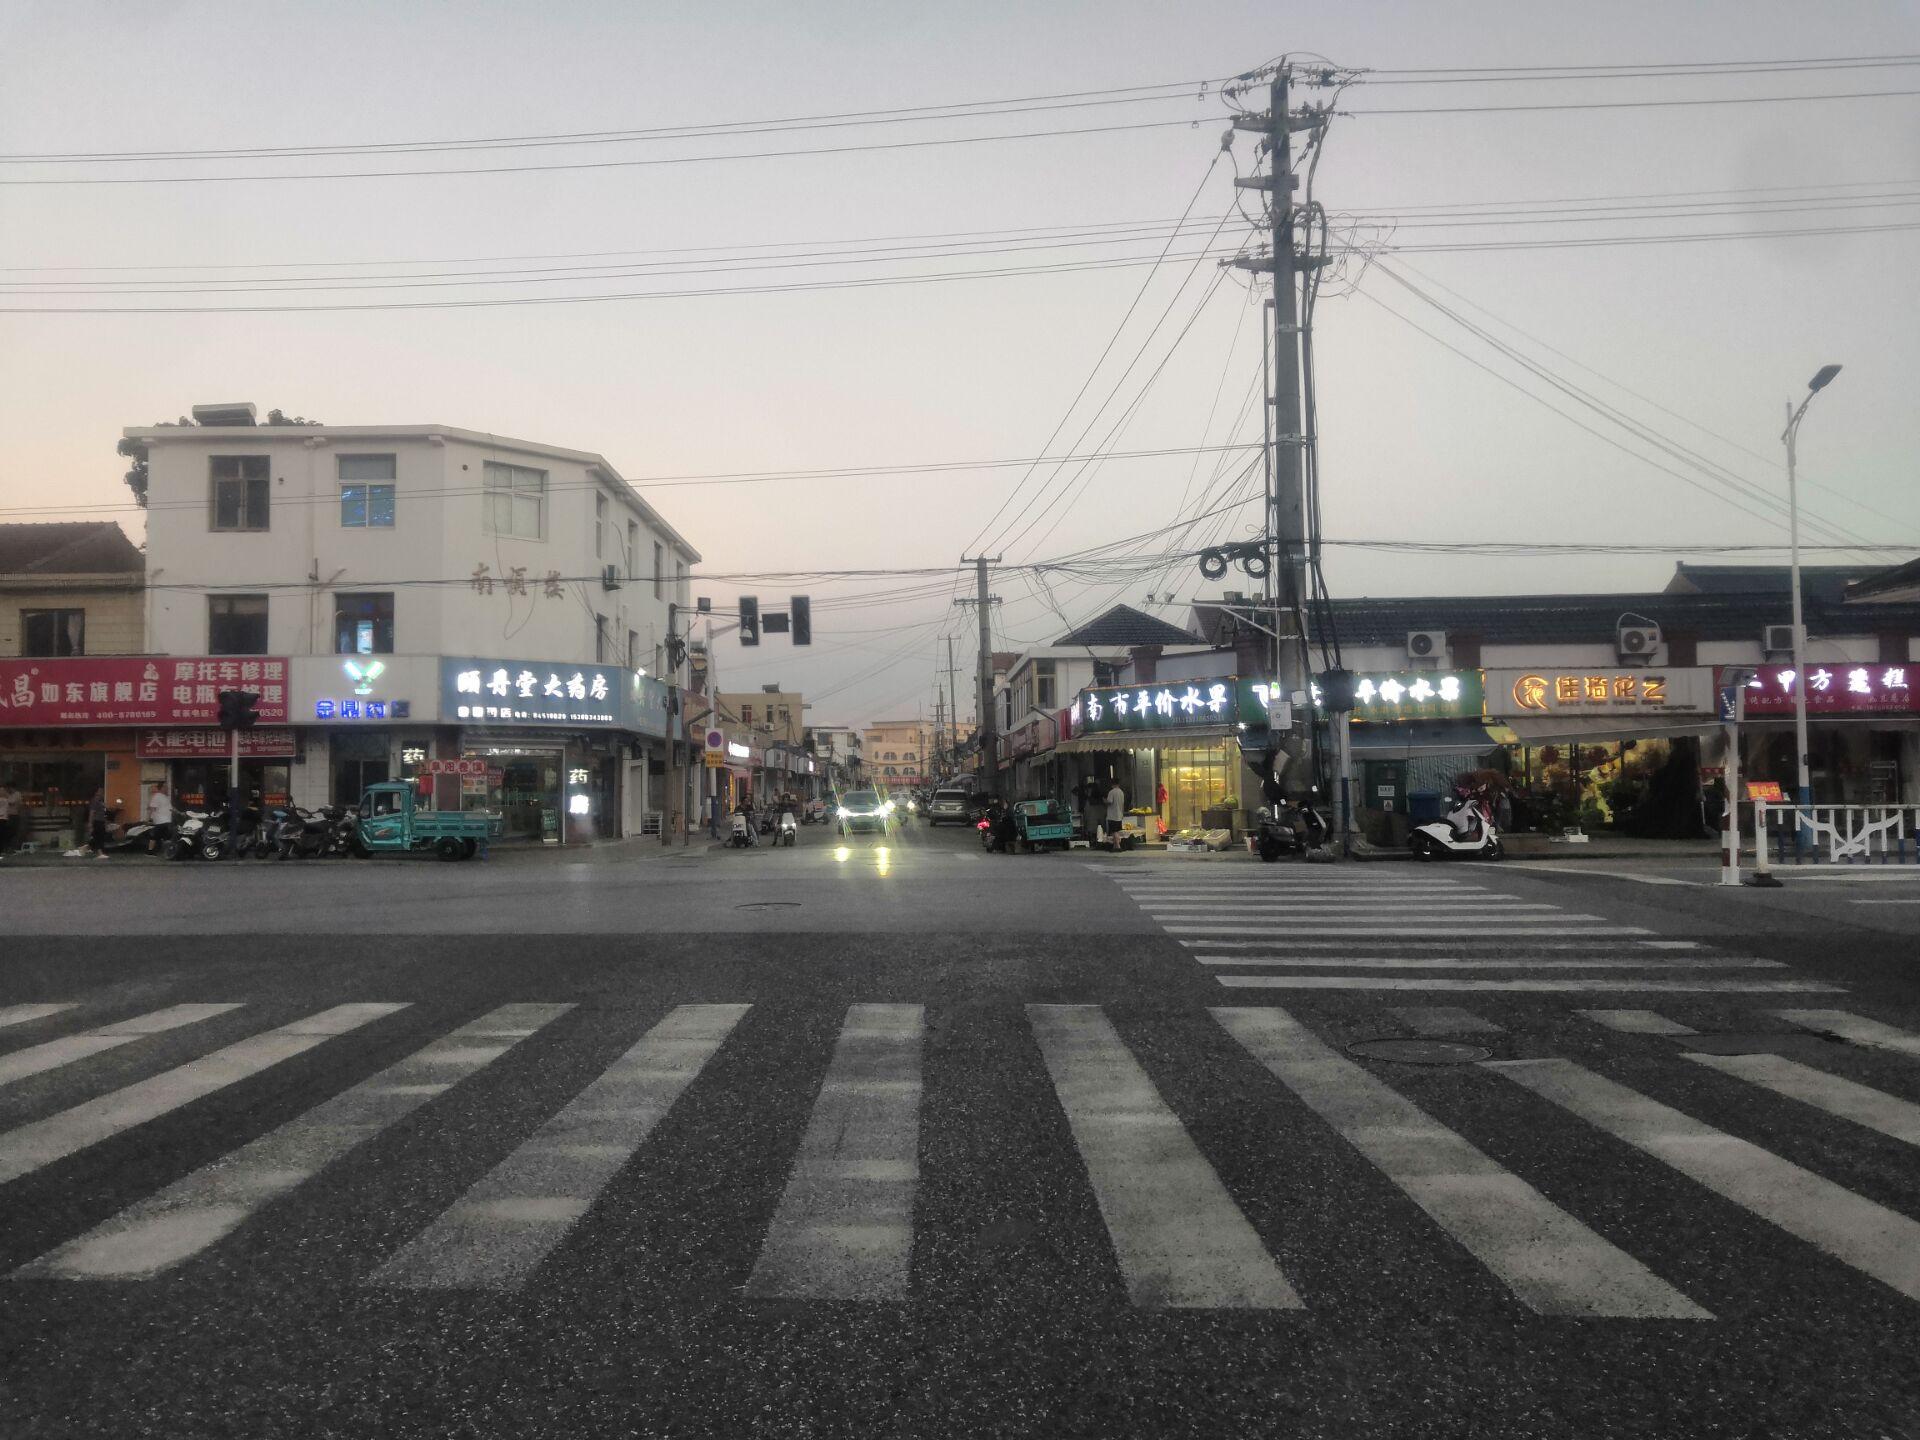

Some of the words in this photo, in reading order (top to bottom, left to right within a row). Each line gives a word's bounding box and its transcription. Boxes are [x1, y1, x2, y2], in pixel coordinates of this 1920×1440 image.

[174, 661, 283, 681] 摩托车修理
[41, 681, 159, 703] 如东旗舰店
